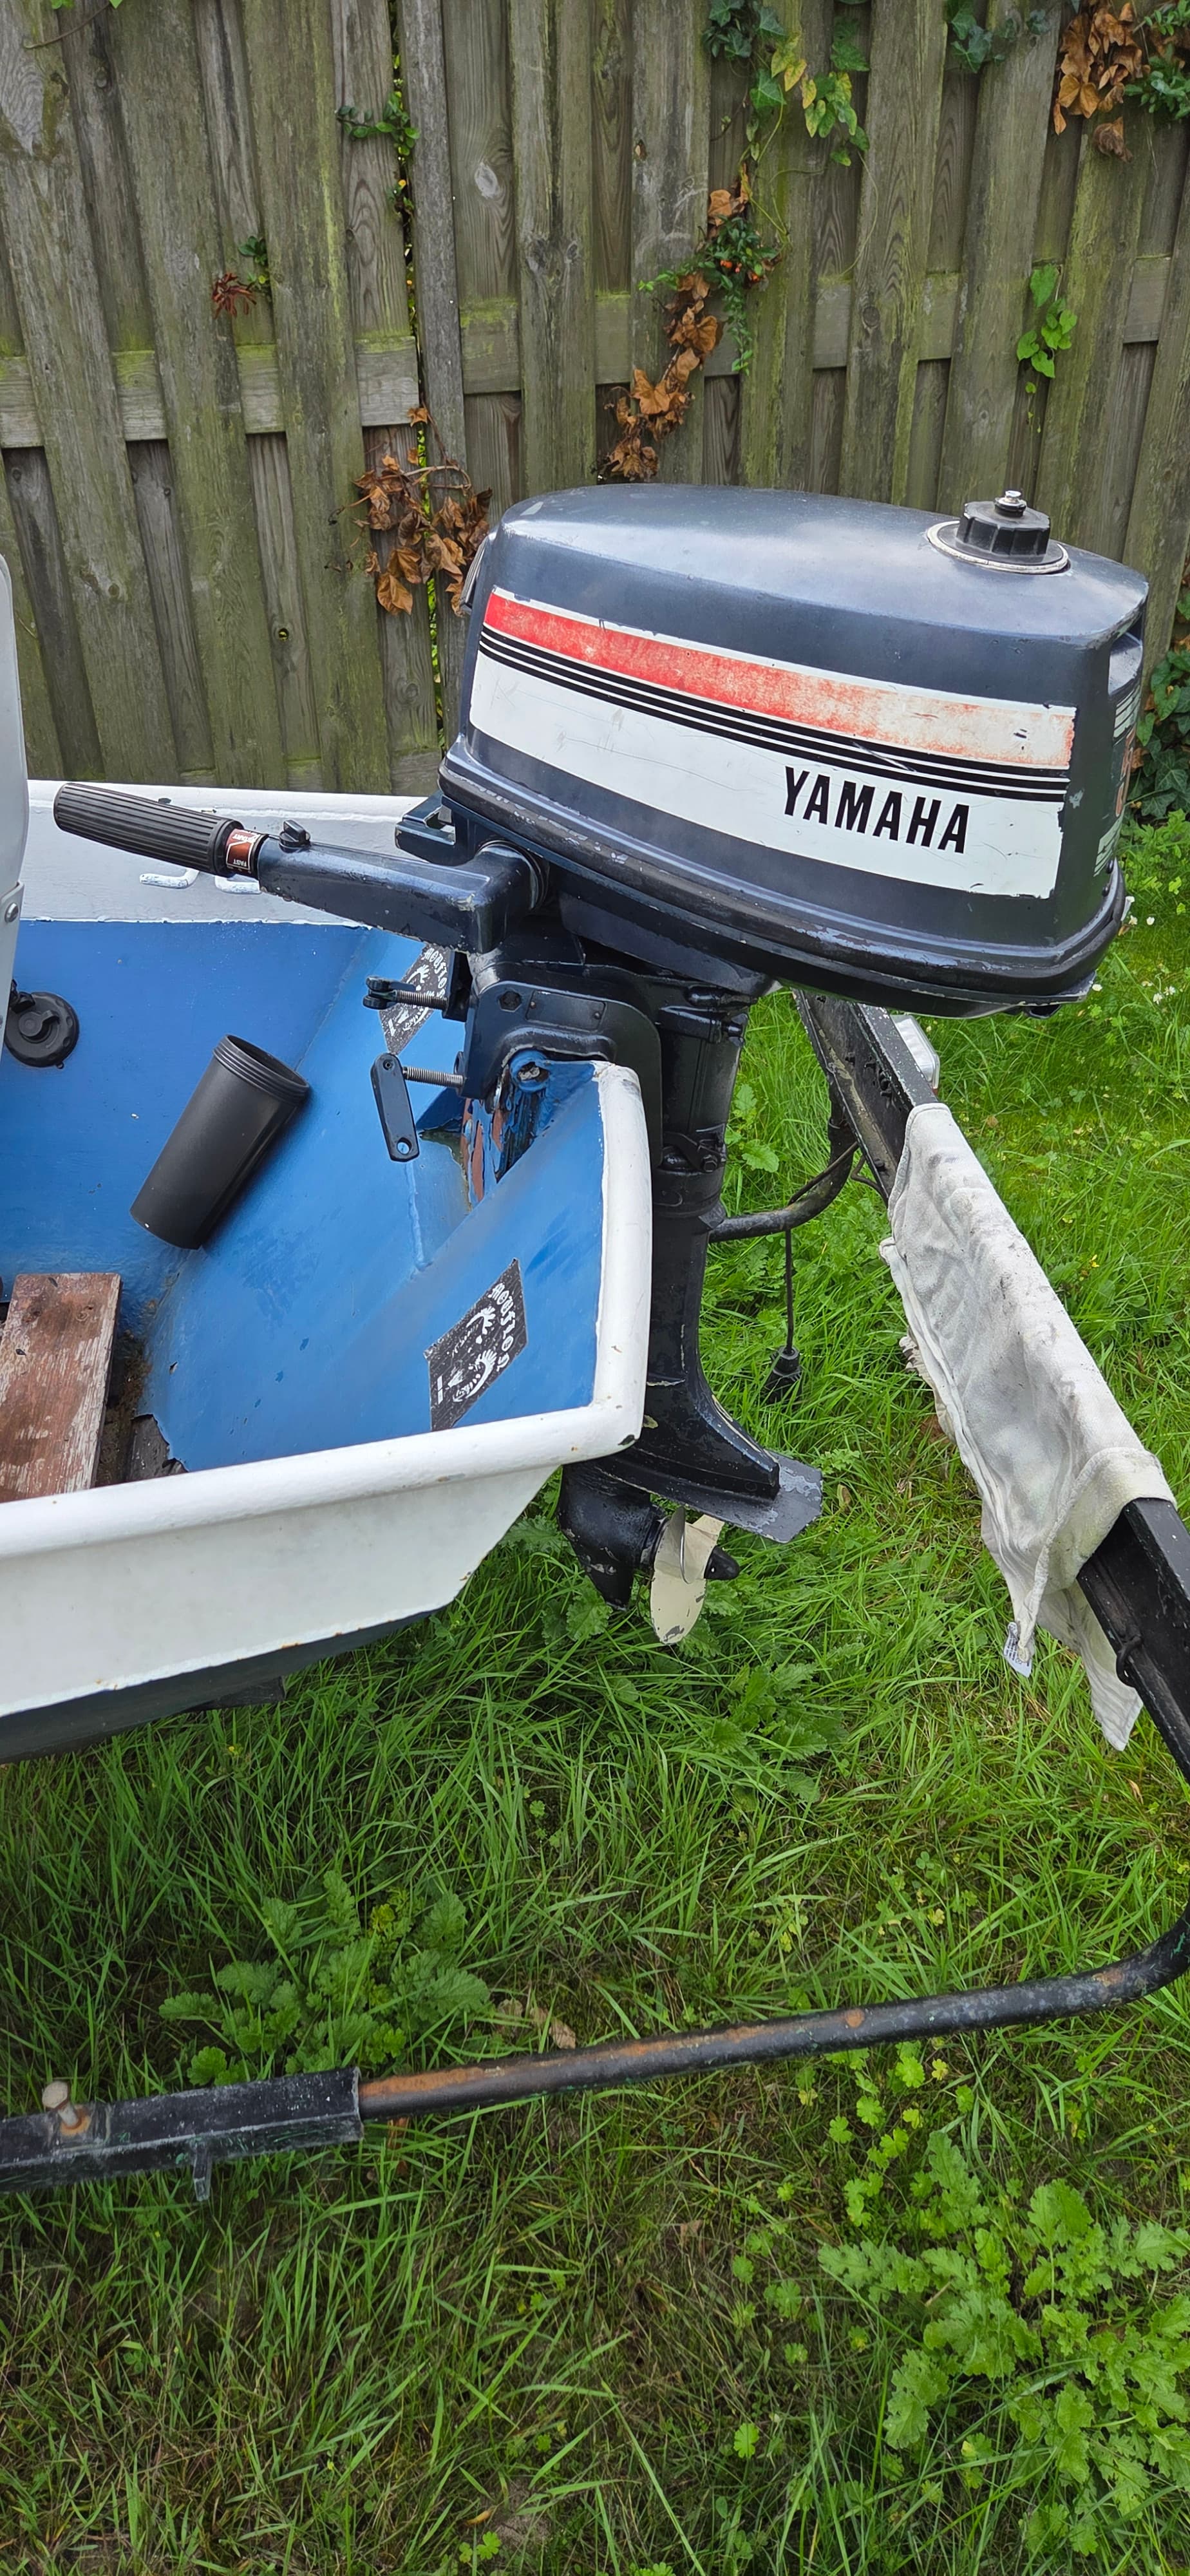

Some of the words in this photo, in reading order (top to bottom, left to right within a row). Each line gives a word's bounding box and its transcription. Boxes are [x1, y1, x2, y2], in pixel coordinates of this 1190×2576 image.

[784, 766, 970, 854] YAMAHA
[233, 858, 247, 867] FAST
[488, 1282, 516, 1372] MOUFLON
